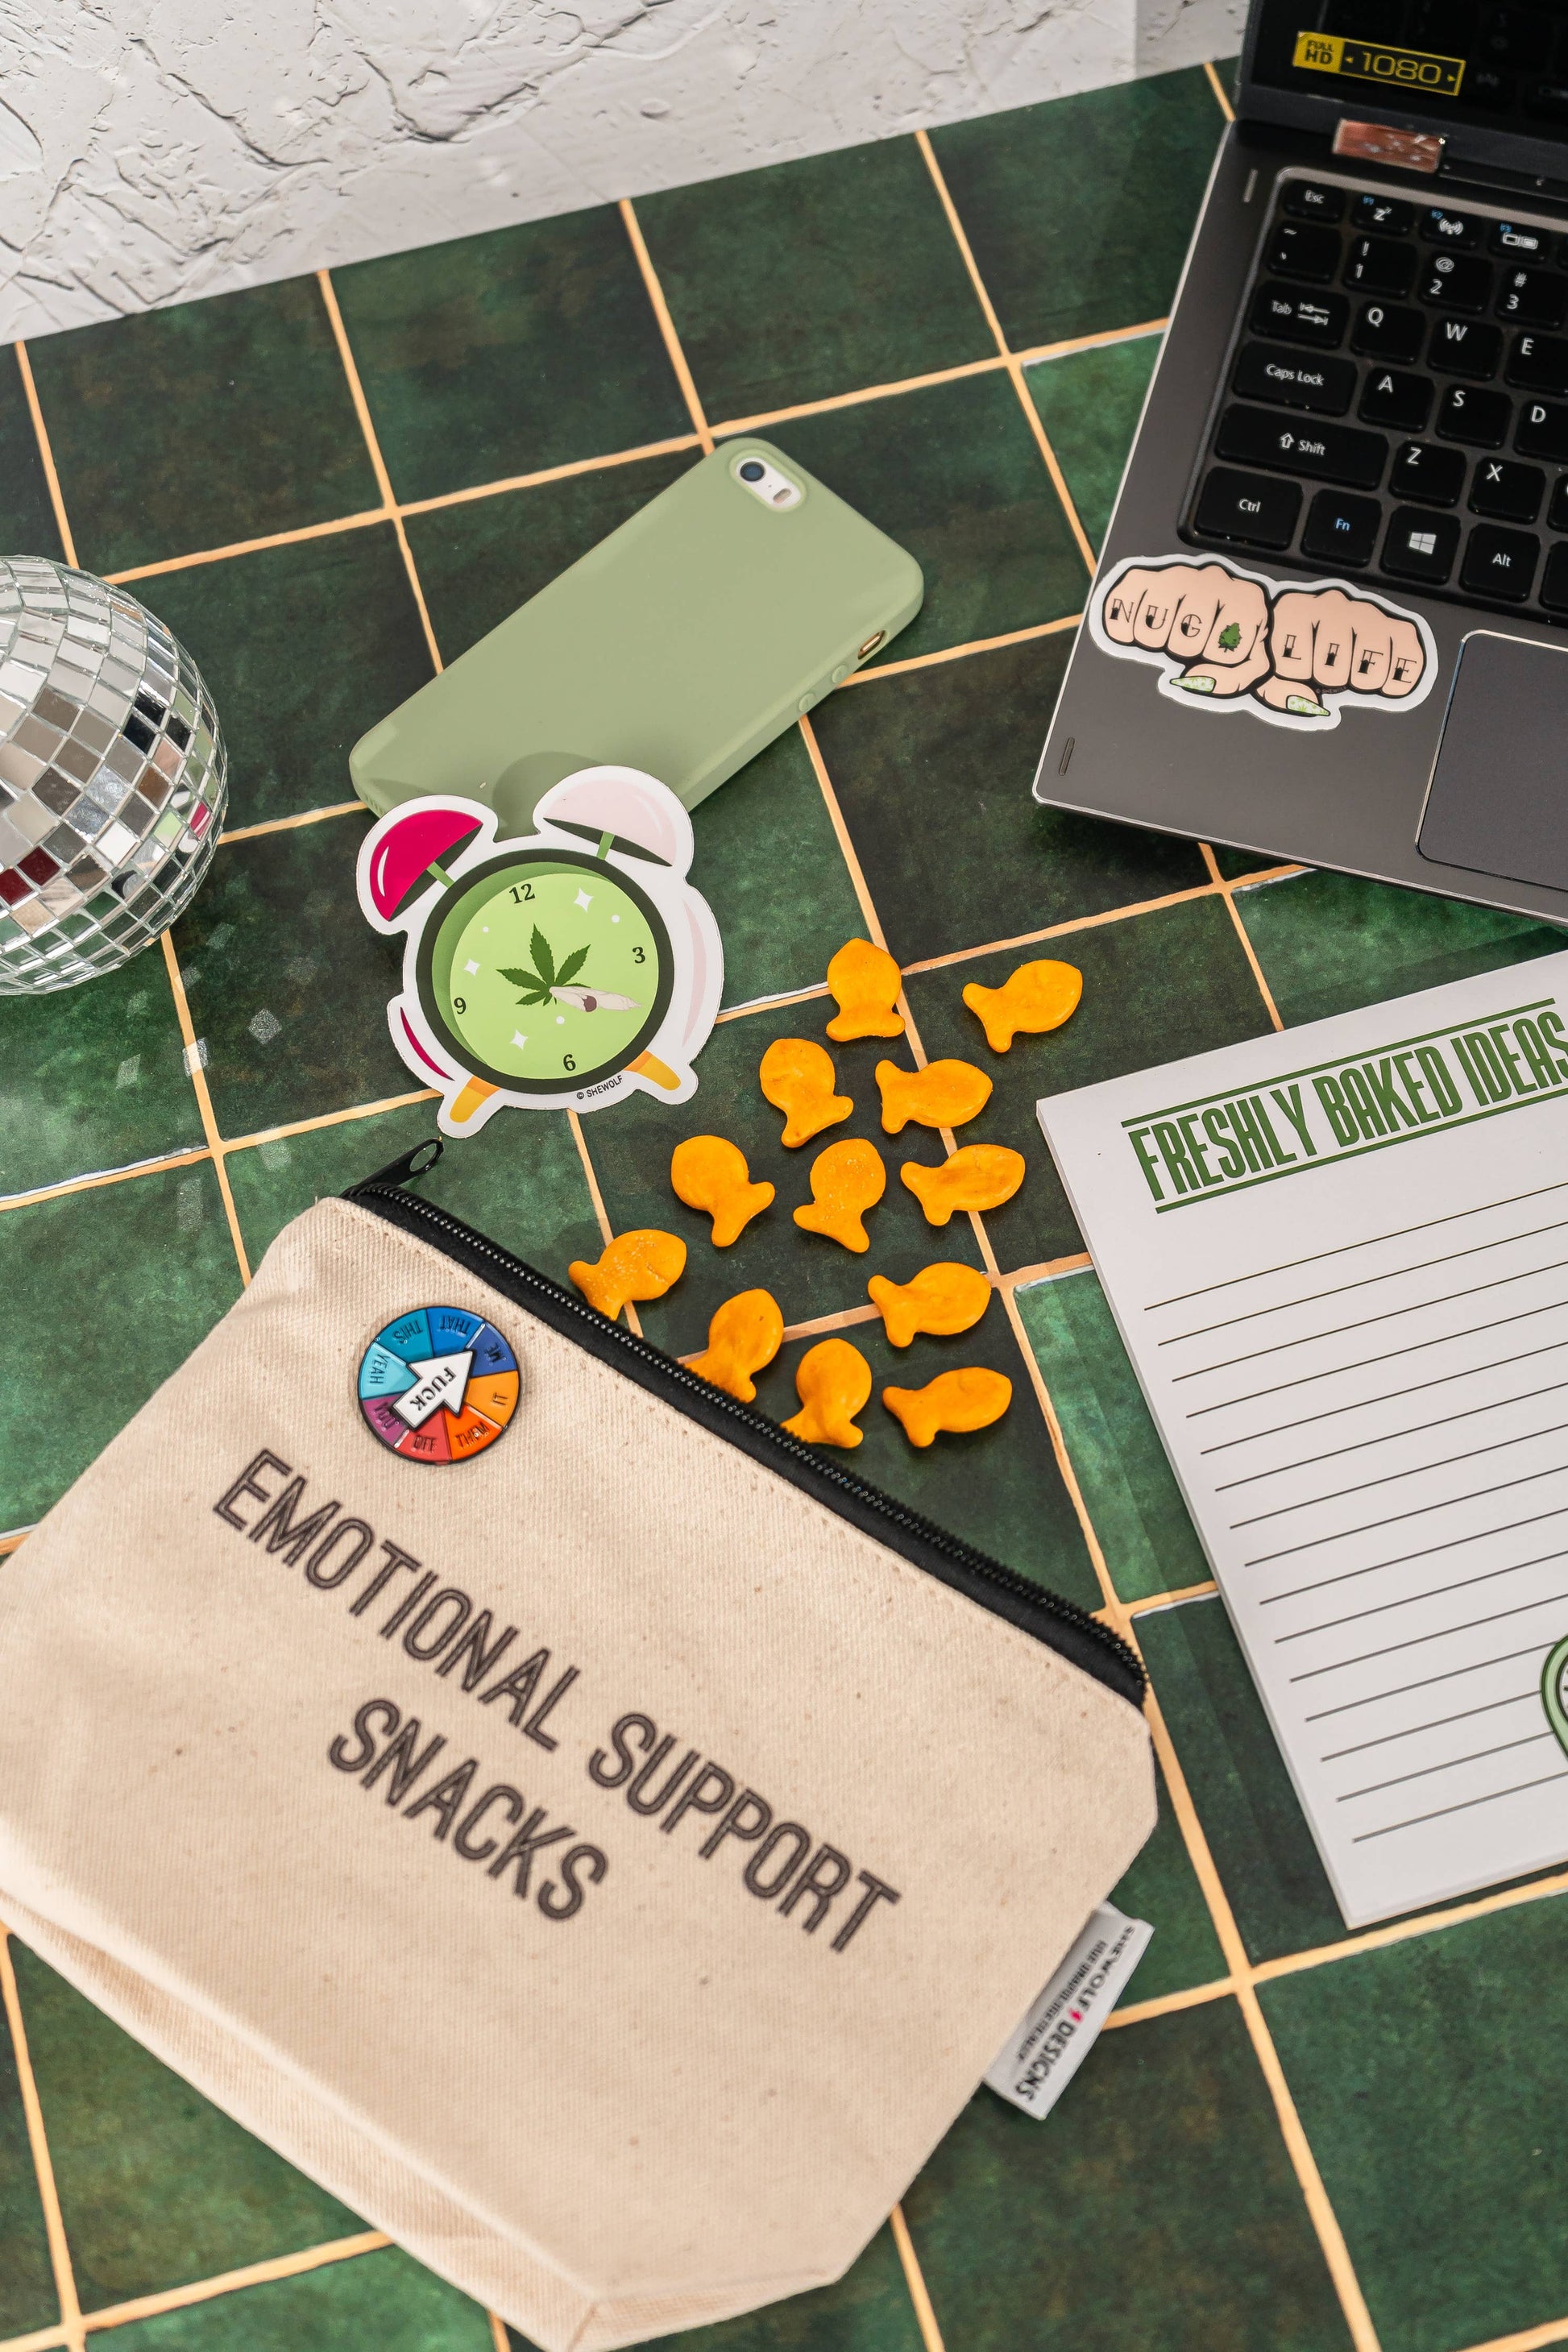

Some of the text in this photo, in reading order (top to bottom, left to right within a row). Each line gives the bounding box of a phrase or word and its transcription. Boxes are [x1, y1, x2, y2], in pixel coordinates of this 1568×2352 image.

[1307, 40, 1334, 52] FULL
[1305, 49, 1334, 64] HD
[1362, 51, 1442, 85] 1080
[1305, 190, 1325, 205] Esc
[1355, 263, 1363, 278] 1
[1435, 257, 1454, 272] @
[1429, 279, 1443, 295] 2
[1514, 272, 1528, 287] #
[1271, 300, 1292, 316] Tab
[1507, 295, 1520, 309] 3
[1367, 308, 1384, 327] Q
[1445, 323, 1467, 342] W
[1521, 338, 1534, 355] E
[1266, 363, 1324, 386] Caps Lock
[1378, 375, 1393, 393] A
[1453, 390, 1466, 407] S
[1531, 406, 1546, 423] D
[1299, 439, 1326, 456] Shift
[1406, 447, 1421, 466] Z
[1485, 463, 1504, 482] X
[1238, 498, 1261, 514] Ctrl
[1334, 517, 1350, 532] Fn
[1492, 553, 1512, 568] Alt
[1109, 599, 1417, 684] NUG LIFE
[508, 883, 536, 904] 12
[632, 946, 646, 964] 3
[453, 997, 467, 1014] 9
[562, 1054, 577, 1072] 6
[586, 1074, 624, 1099] SHEWOLF
[1128, 1011, 1568, 1202] FRESHLY BAKED IDEAS
[392, 1319, 424, 1345] THIS
[440, 1314, 471, 1335] THAT
[483, 1342, 504, 1363] ME
[369, 1353, 392, 1385] YEAH
[409, 1366, 457, 1412] FUCK
[492, 1392, 508, 1406] IT
[375, 1401, 400, 1430] YOU
[413, 1434, 438, 1453] OFF
[455, 1421, 490, 1449] THEM
[212, 1449, 903, 1956] EMOTIONAL SUPPORT
[328, 1698, 610, 1922] SNACKS
[1015, 2018, 1077, 2102] DESIGNS
